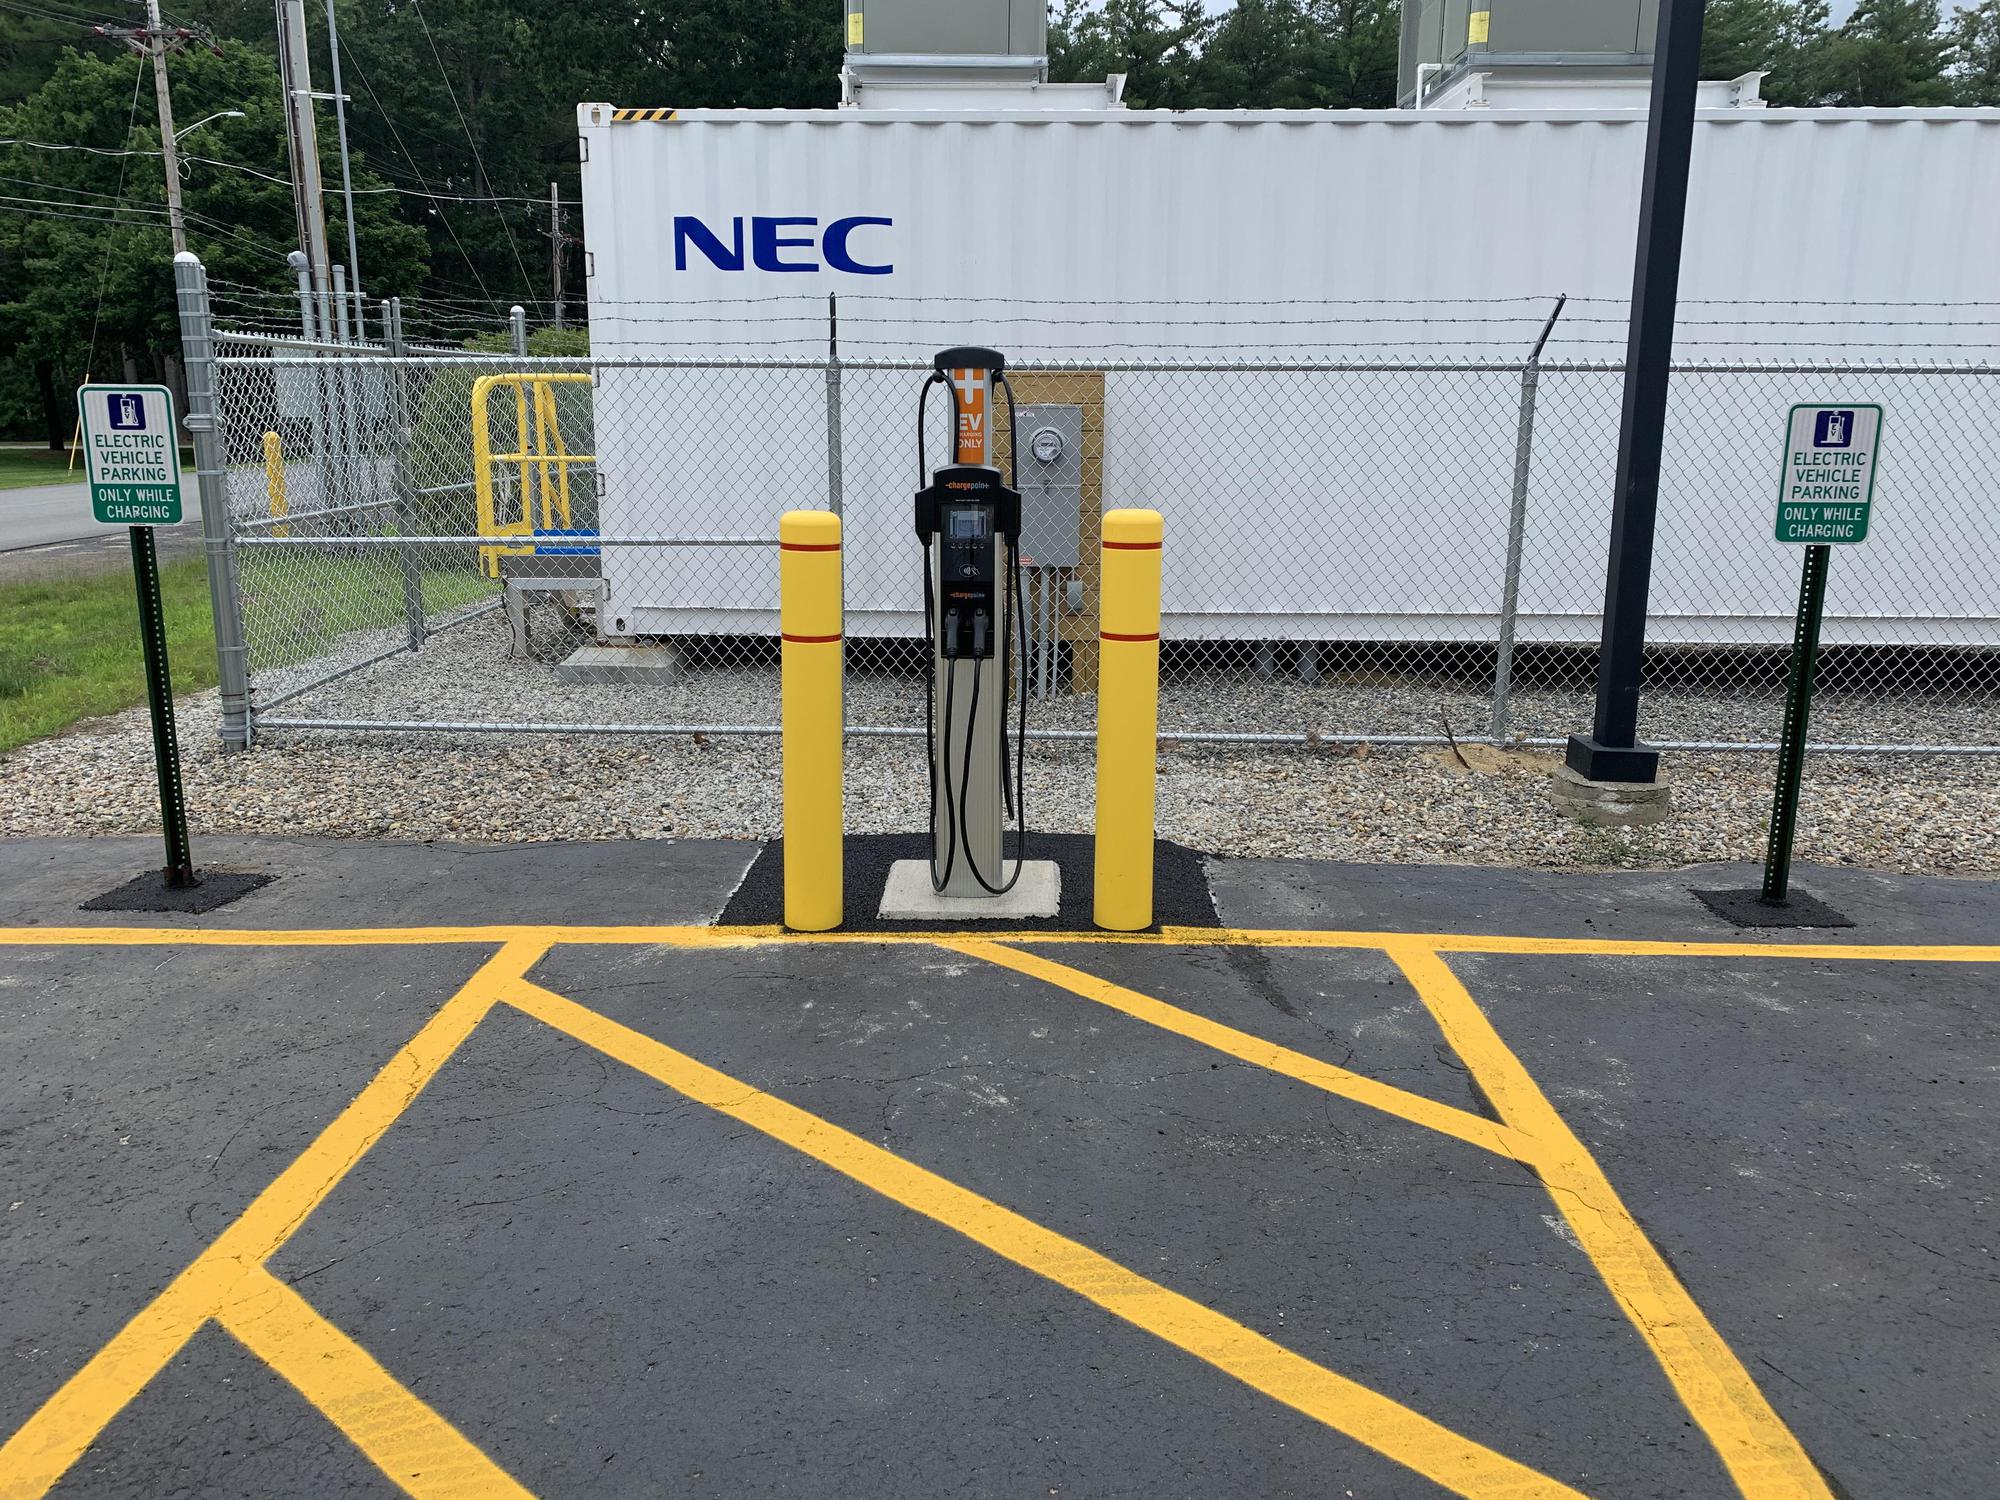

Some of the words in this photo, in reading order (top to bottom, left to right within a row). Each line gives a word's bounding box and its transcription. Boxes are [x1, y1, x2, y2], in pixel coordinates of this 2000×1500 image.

[674, 216, 893, 275] NEC
[960, 413, 982, 431] EV
[95, 434, 165, 448] ELECTRIC
[100, 451, 164, 464] VEHICLE
[1793, 452, 1867, 466] ELECTRIC
[101, 467, 166, 481] PARKING
[1796, 469, 1861, 482] VEHICLE
[98, 488, 131, 502] ONLY
[136, 488, 174, 502] WHILE
[1791, 486, 1860, 499] PARKING
[107, 505, 170, 519] CHARGING
[1784, 507, 1819, 520] ONLY
[1823, 507, 1863, 520] WHILE
[1788, 524, 1855, 538] CHARGING
